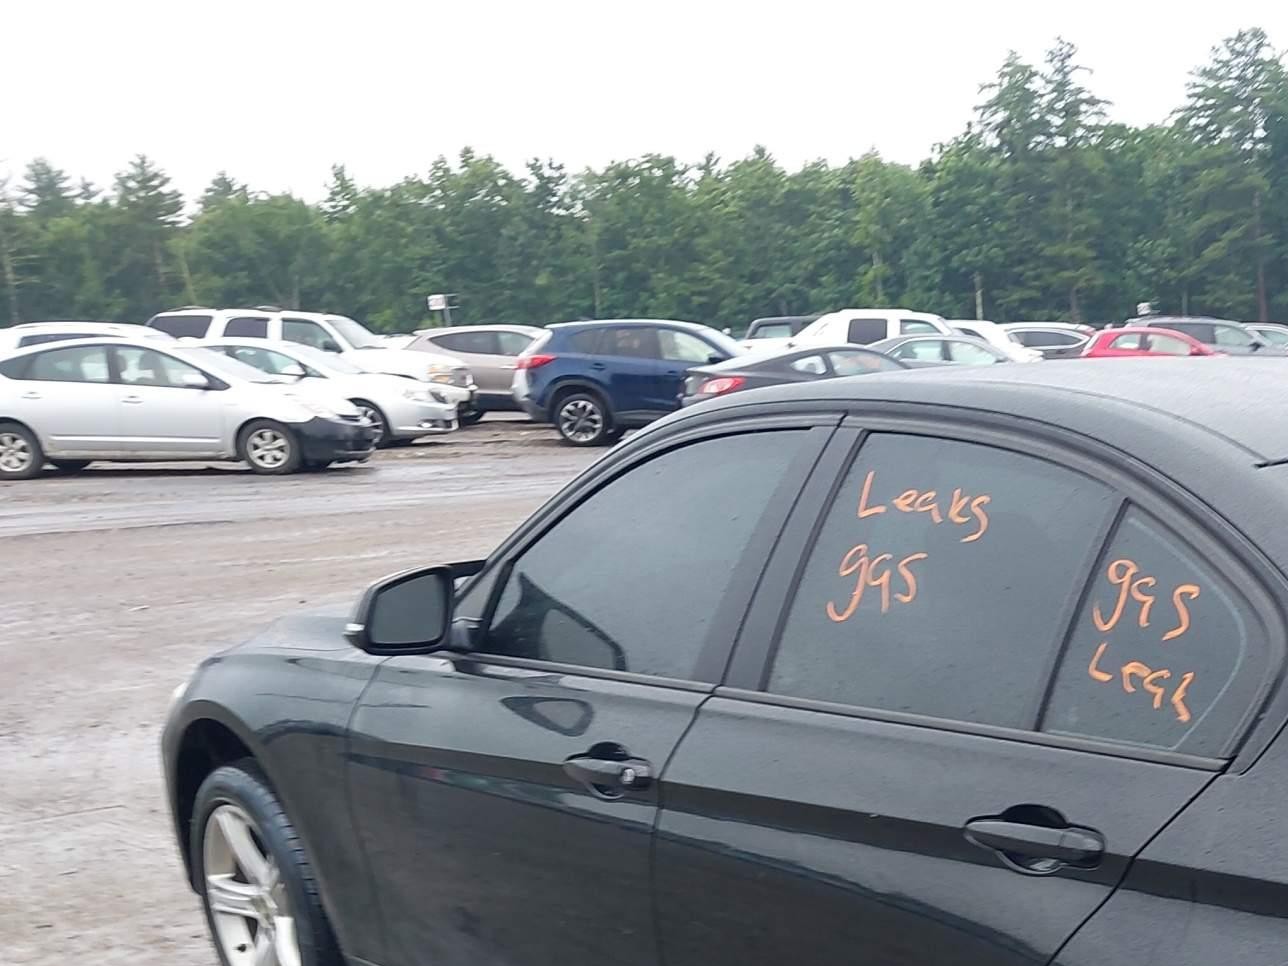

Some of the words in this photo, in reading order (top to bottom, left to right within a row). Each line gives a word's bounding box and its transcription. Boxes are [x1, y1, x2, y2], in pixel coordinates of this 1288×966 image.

[857, 471, 992, 542] Leaks
[826, 544, 929, 622] gas
[1092, 559, 1201, 641] gas
